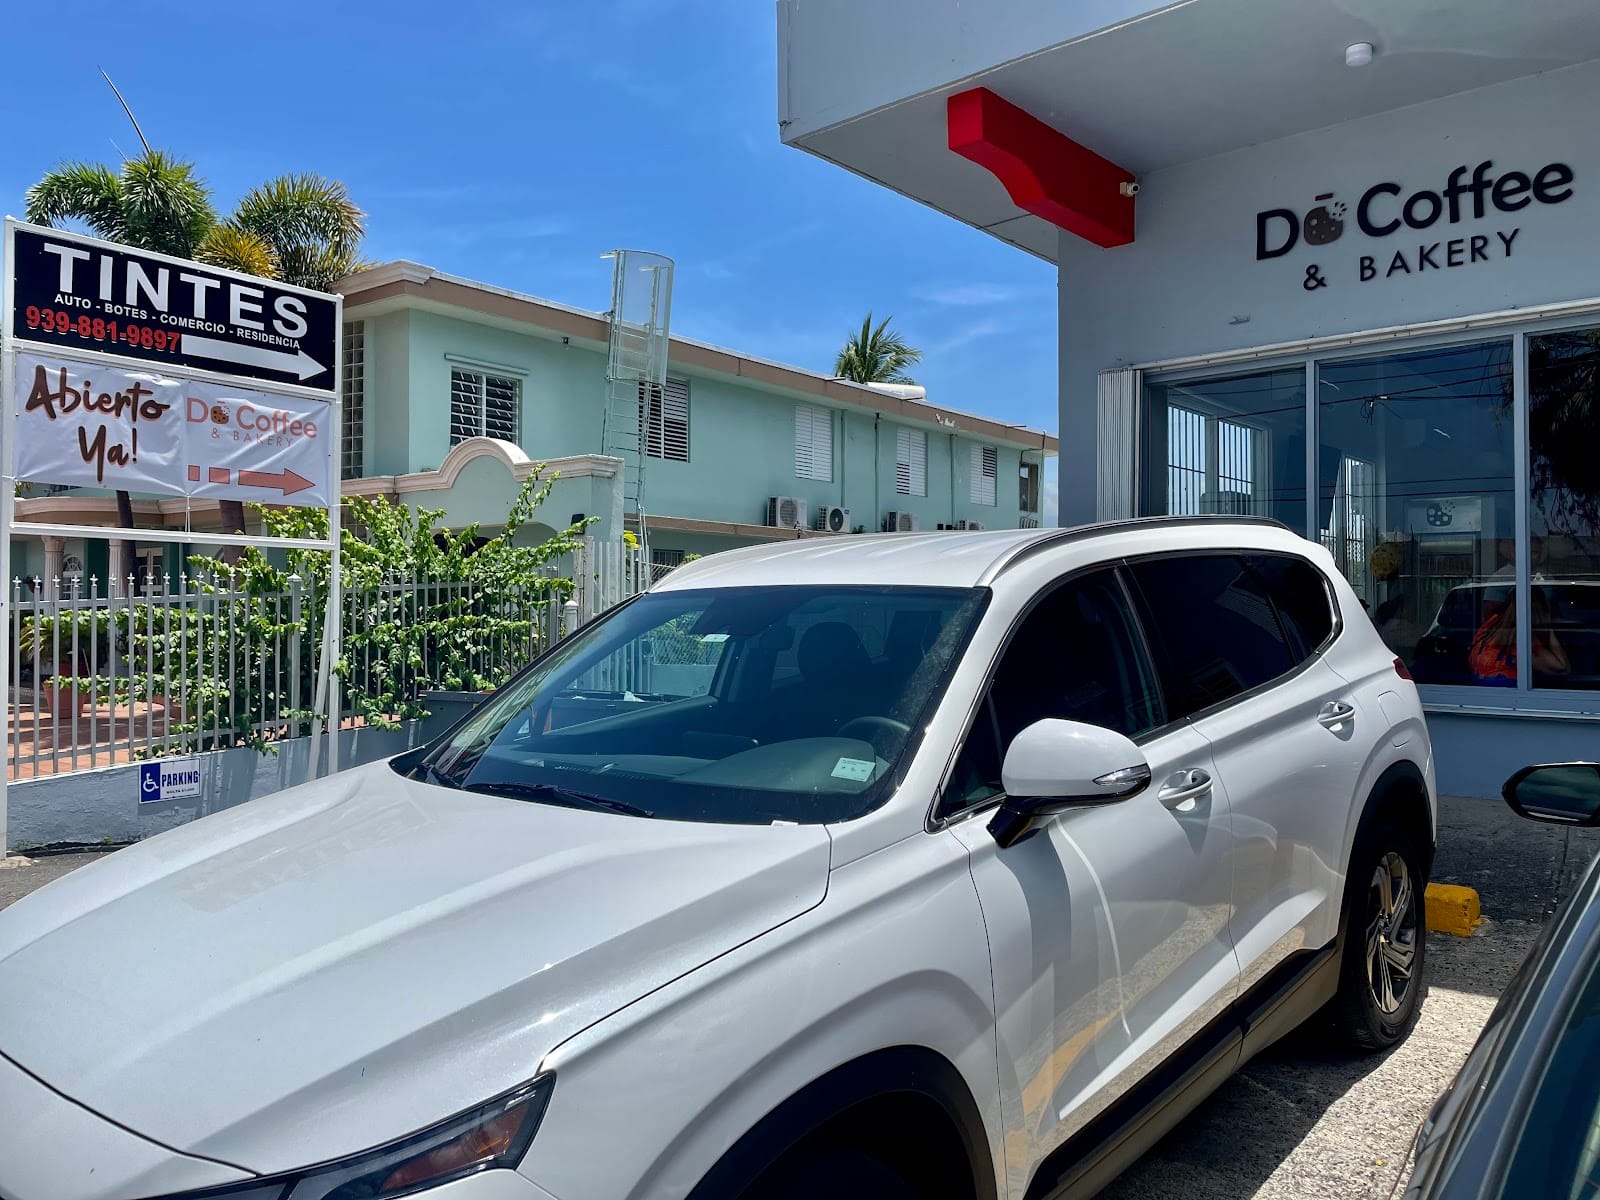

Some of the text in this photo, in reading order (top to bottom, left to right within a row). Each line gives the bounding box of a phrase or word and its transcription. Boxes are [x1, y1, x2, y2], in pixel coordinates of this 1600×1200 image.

[1356, 160, 1574, 237] Coffee
[1303, 228, 1520, 291] & BAKERY
[43, 242, 309, 338] TINTES
[26, 305, 180, 354] 939-881-9897
[54, 293, 92, 309] AUTO
[104, 303, 148, 320] BOTES
[160, 313, 226, 334] COMERCIO
[236, 327, 300, 349] RESIDENCIA
[25, 364, 171, 423] Abierto
[236, 405, 318, 439] Coffee
[78, 424, 138, 483] Ya!
[211, 427, 293, 448] & BAKERY
[161, 770, 199, 788] PARKING
